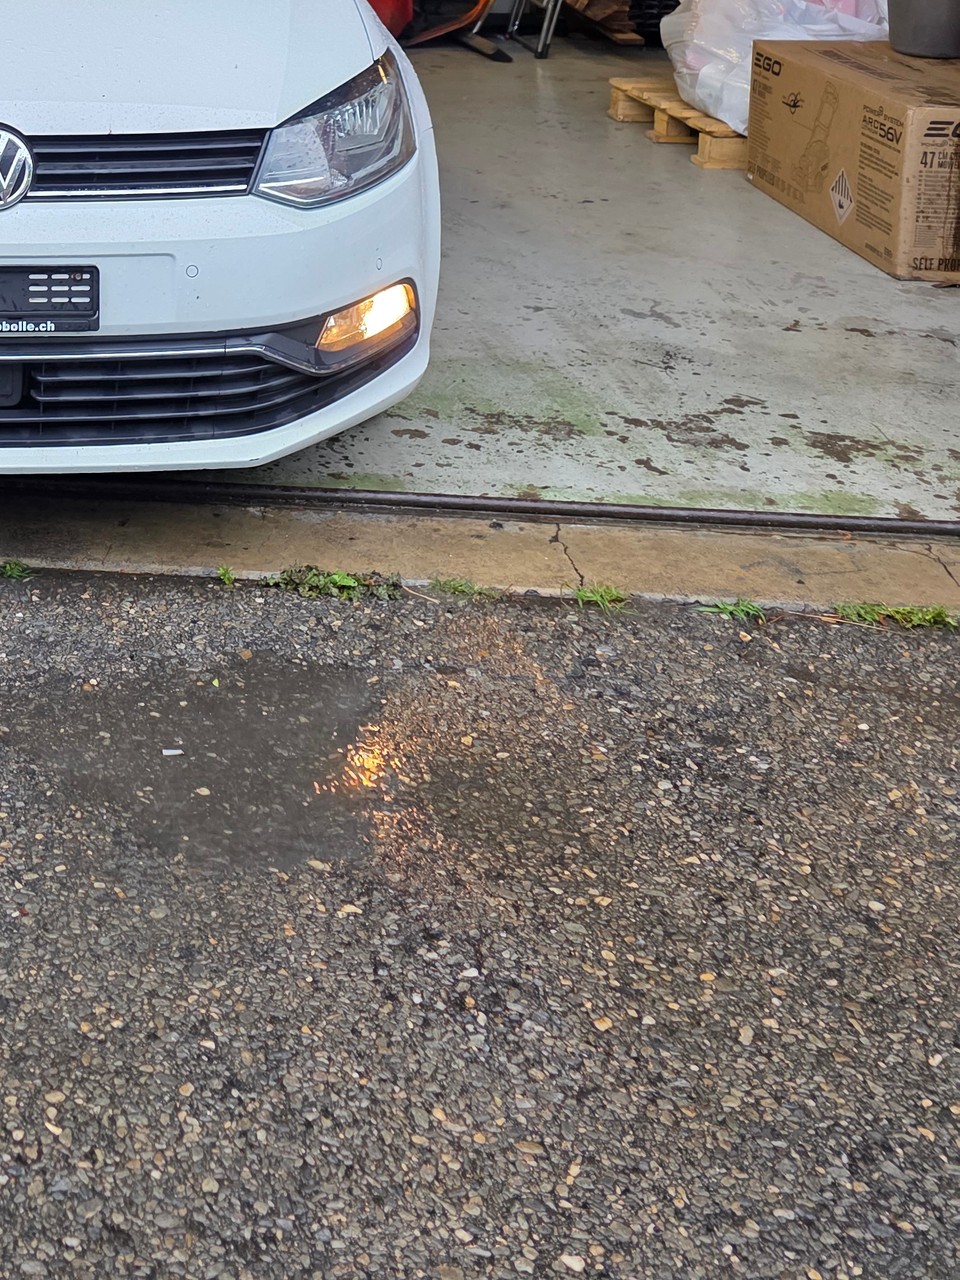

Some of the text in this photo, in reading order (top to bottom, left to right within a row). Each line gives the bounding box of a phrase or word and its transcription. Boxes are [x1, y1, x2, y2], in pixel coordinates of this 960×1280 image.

[754, 51, 782, 77] EGO
[862, 114, 878, 130] ARC
[878, 122, 903, 145] 56V
[920, 151, 936, 168] 47
[913, 256, 935, 272] SELF
